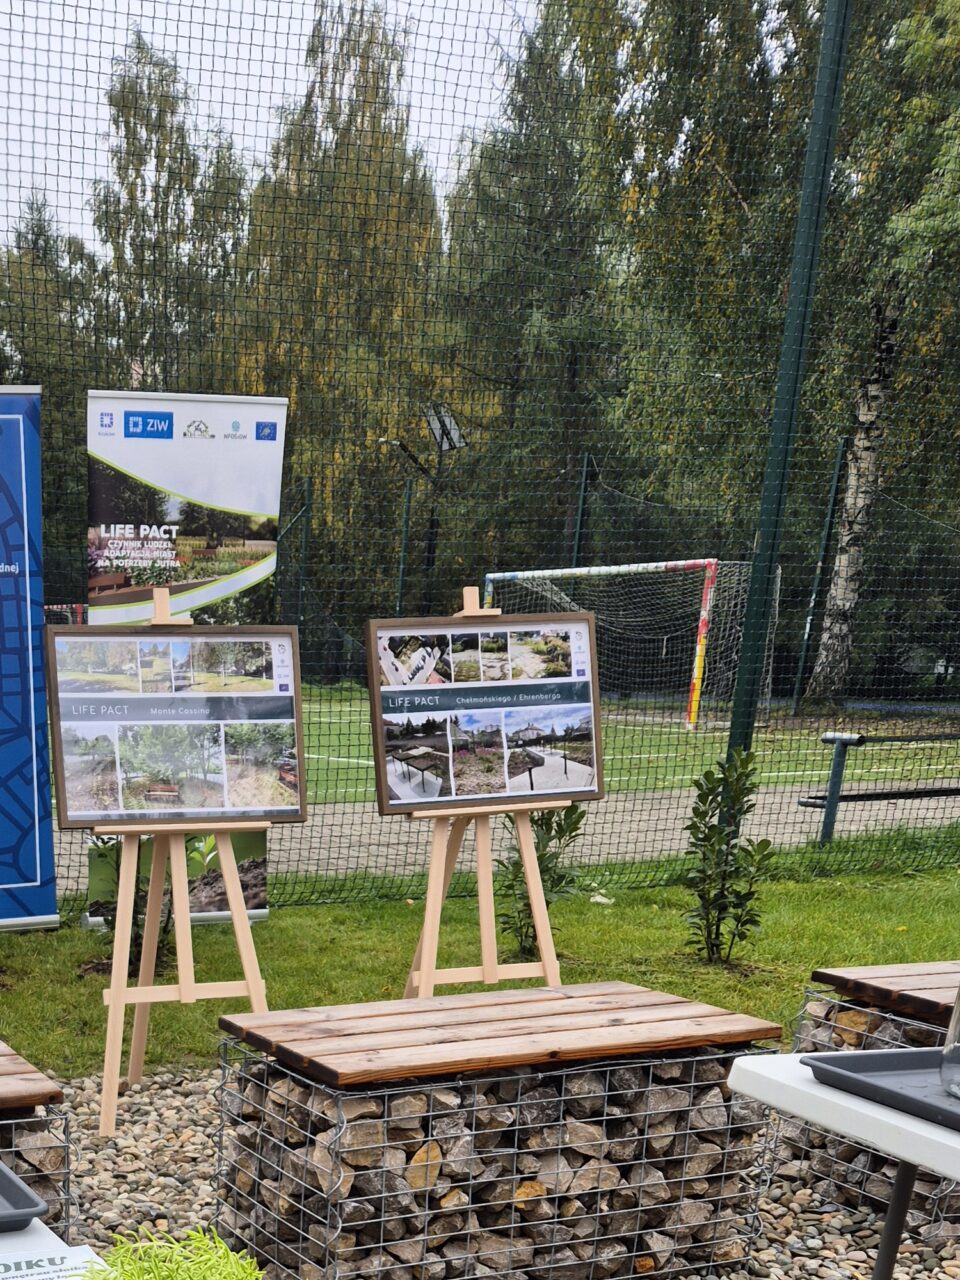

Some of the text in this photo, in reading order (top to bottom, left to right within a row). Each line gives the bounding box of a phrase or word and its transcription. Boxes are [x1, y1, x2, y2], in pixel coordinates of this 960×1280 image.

[147, 419, 168, 431] ZIW
[101, 524, 180, 539] LIFE PACT
[389, 698, 411, 708] LIFE
[414, 696, 440, 706] PACT
[456, 694, 512, 705] Chełmońskiego
[519, 693, 561, 701] Ehrenberga
[72, 704, 97, 715] LIFE
[101, 704, 129, 715] PACT
[150, 707, 176, 715] Monte
